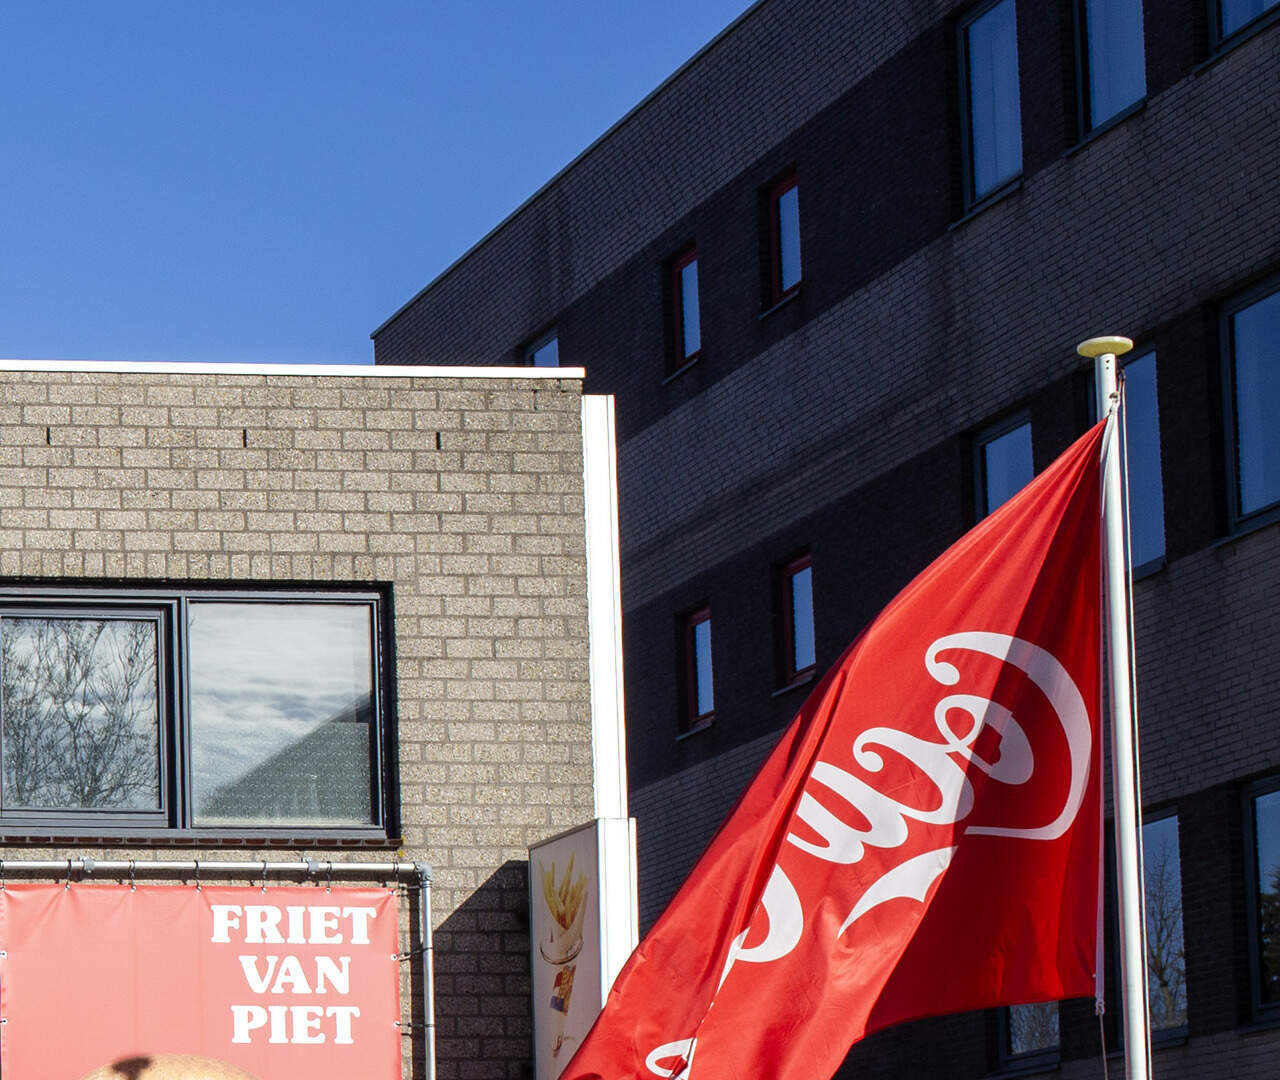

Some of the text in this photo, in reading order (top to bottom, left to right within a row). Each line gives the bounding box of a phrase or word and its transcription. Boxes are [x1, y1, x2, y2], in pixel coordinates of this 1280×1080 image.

[210, 904, 377, 945] FRIET
[239, 955, 351, 994] VAN
[231, 1005, 360, 1045] PIET
